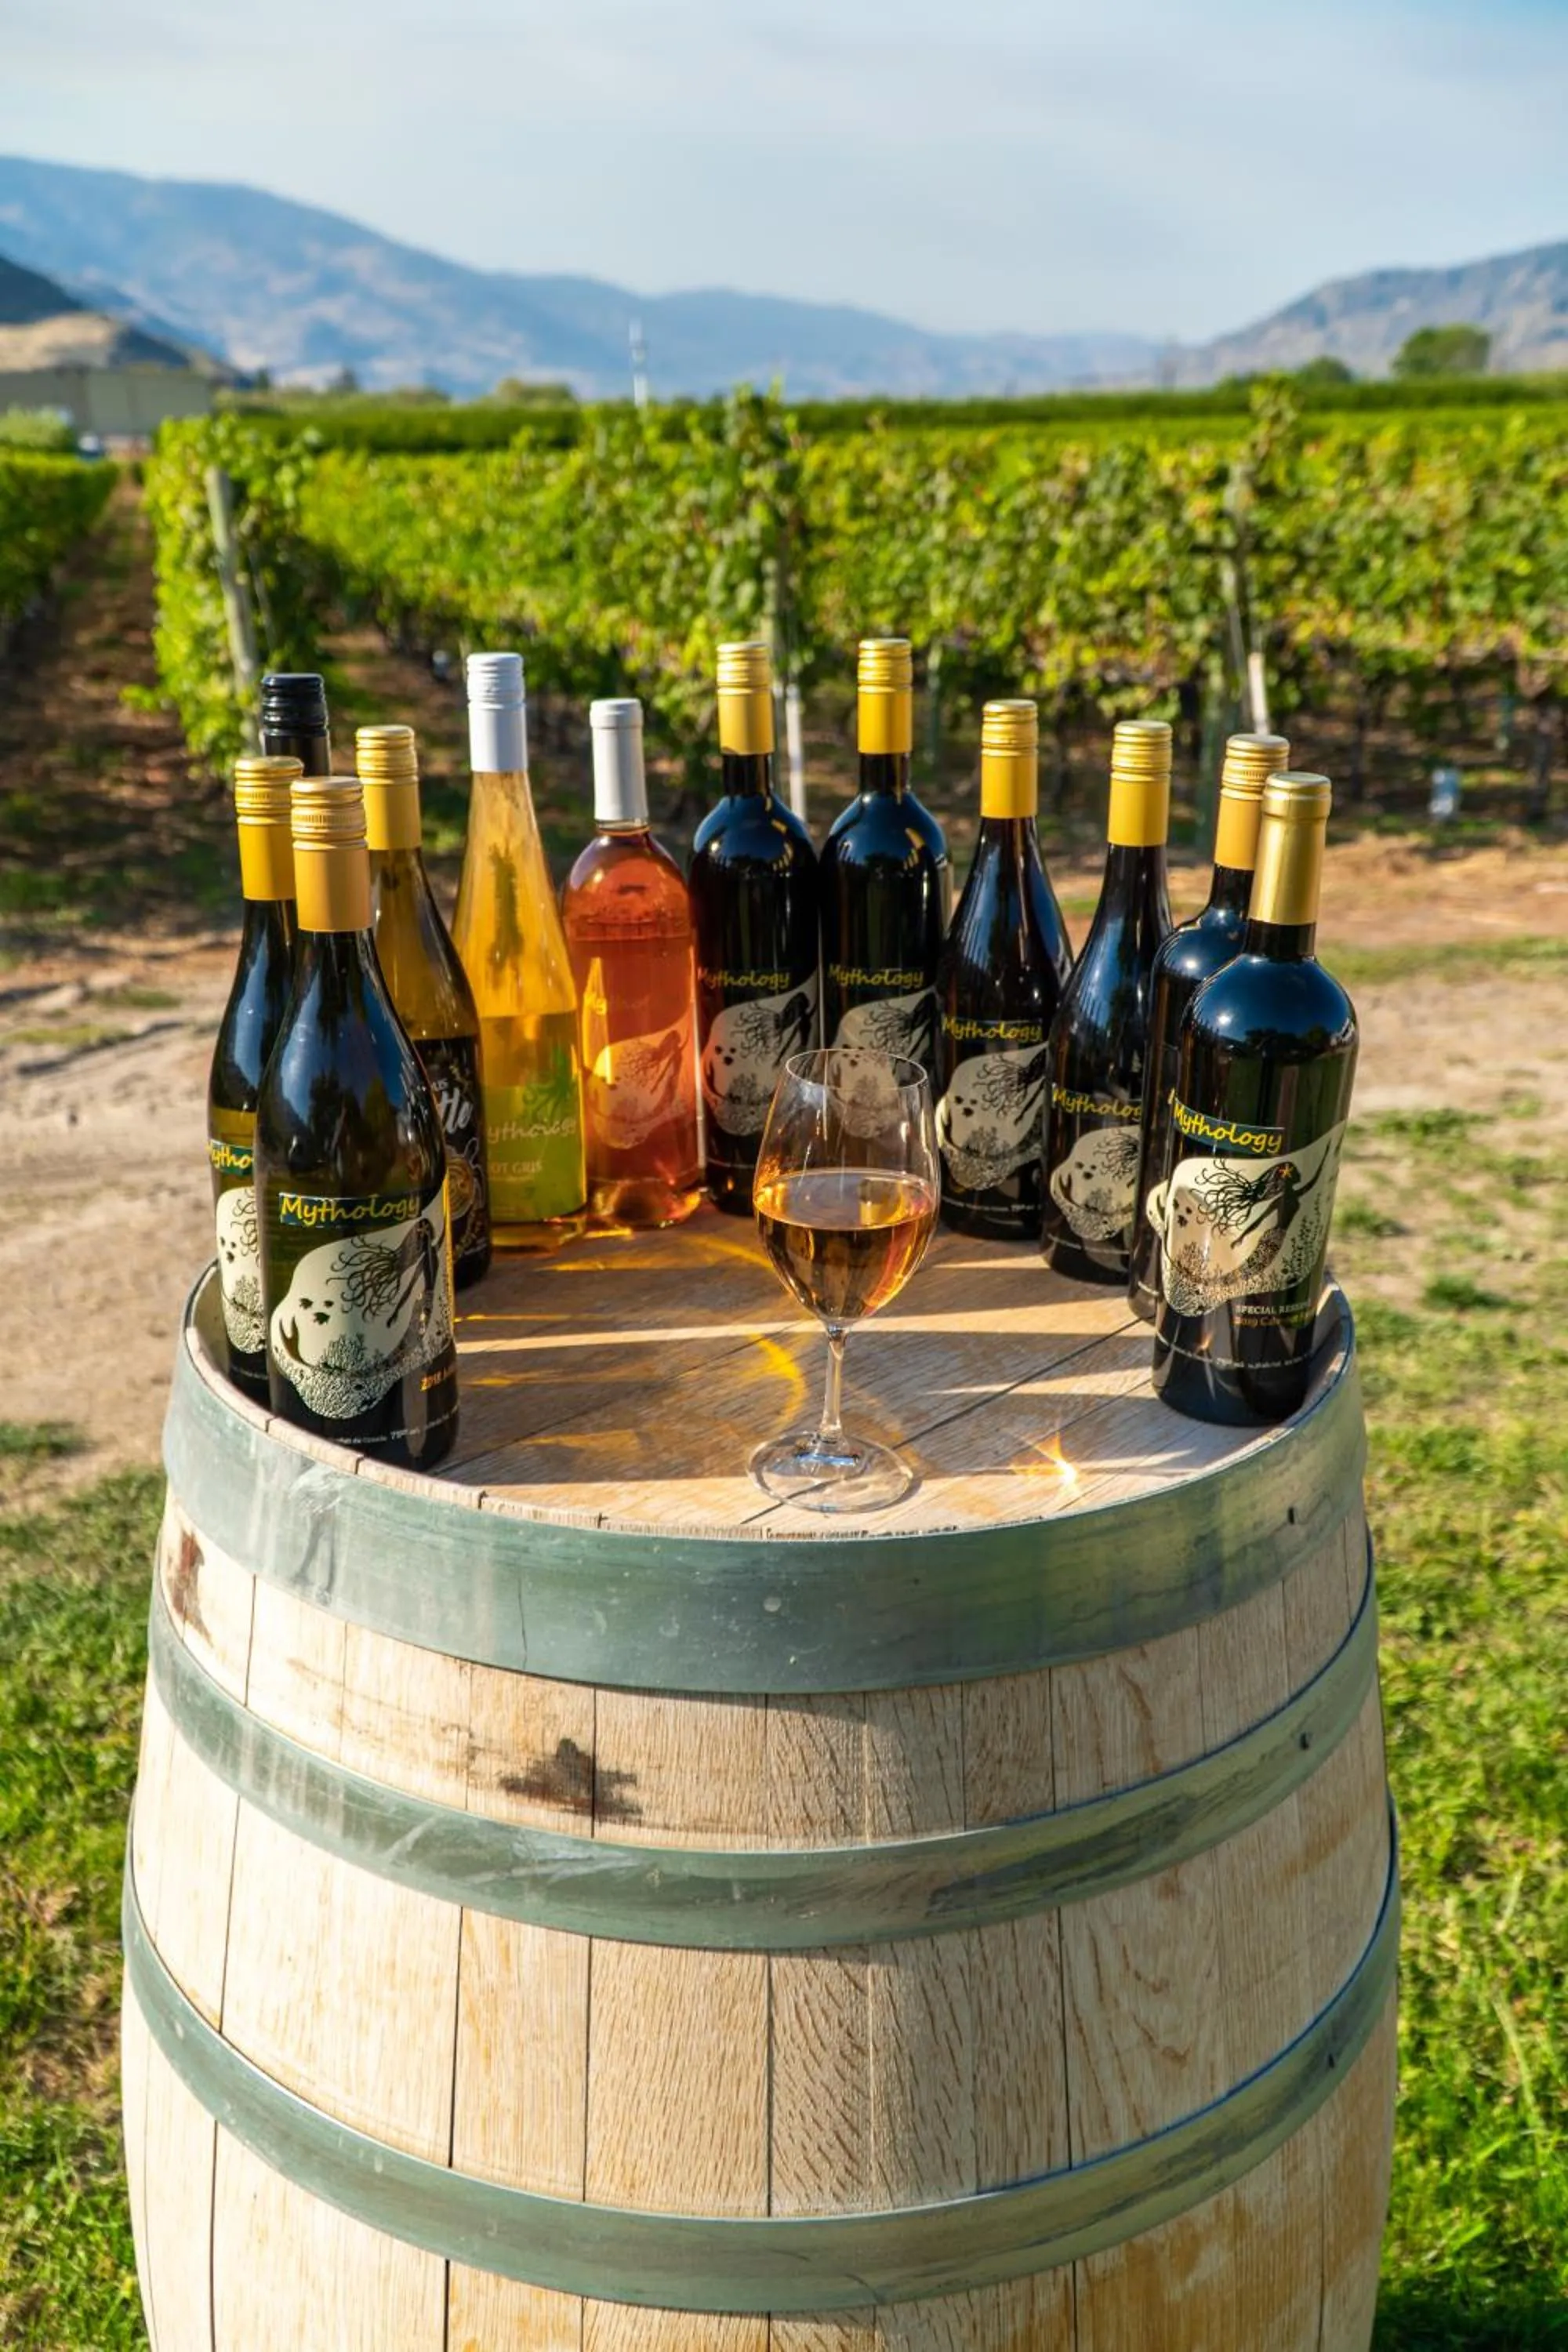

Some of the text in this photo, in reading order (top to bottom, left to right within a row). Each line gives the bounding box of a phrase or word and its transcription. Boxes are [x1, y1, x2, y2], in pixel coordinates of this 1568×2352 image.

[697, 967, 789, 989] Mythology
[829, 964, 924, 989] Mythology
[942, 1014, 1042, 1043] Mythology
[1052, 1087, 1142, 1120] Mytholo
[1174, 1101, 1282, 1155] Mythology
[281, 1194, 420, 1226] Mythology
